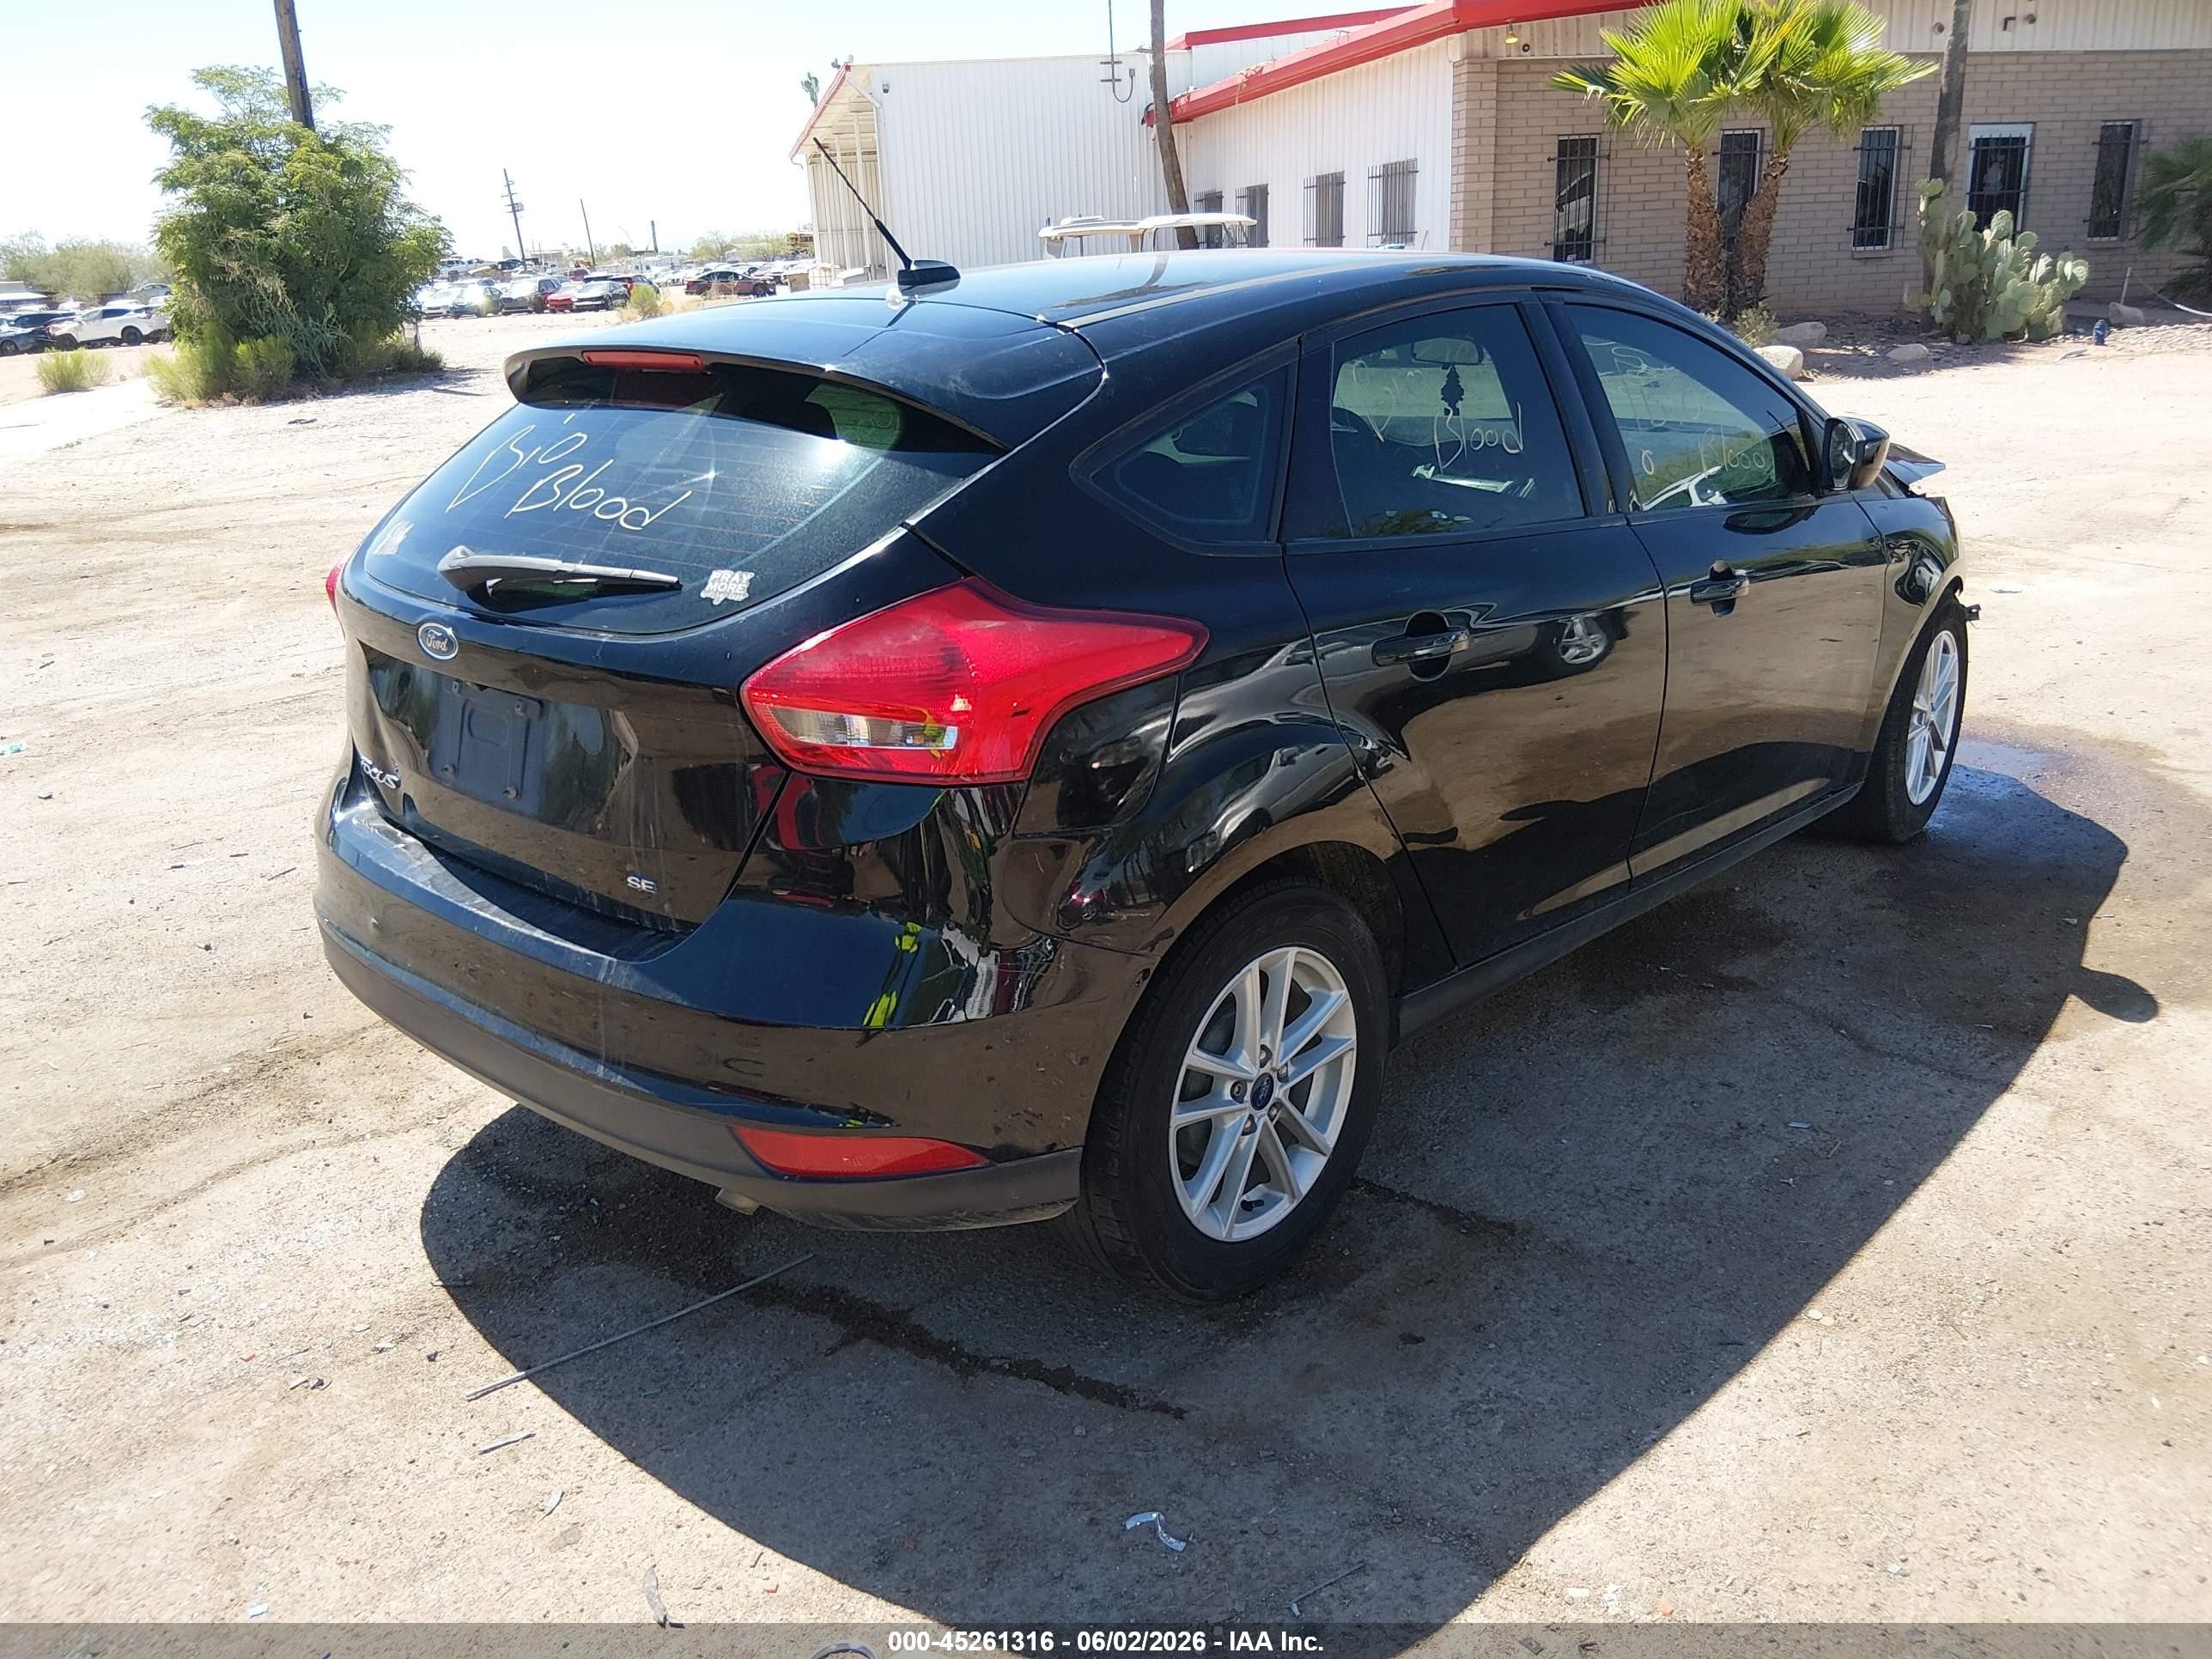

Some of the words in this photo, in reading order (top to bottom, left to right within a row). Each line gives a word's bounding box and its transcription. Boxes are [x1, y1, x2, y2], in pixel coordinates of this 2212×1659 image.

[1433, 401, 1523, 475] Blood
[504, 459, 692, 530] Blood
[705, 581, 747, 593] MORE
[710, 571, 753, 584] PRAY
[426, 629, 447, 652] Ford
[627, 876, 656, 894] SE
